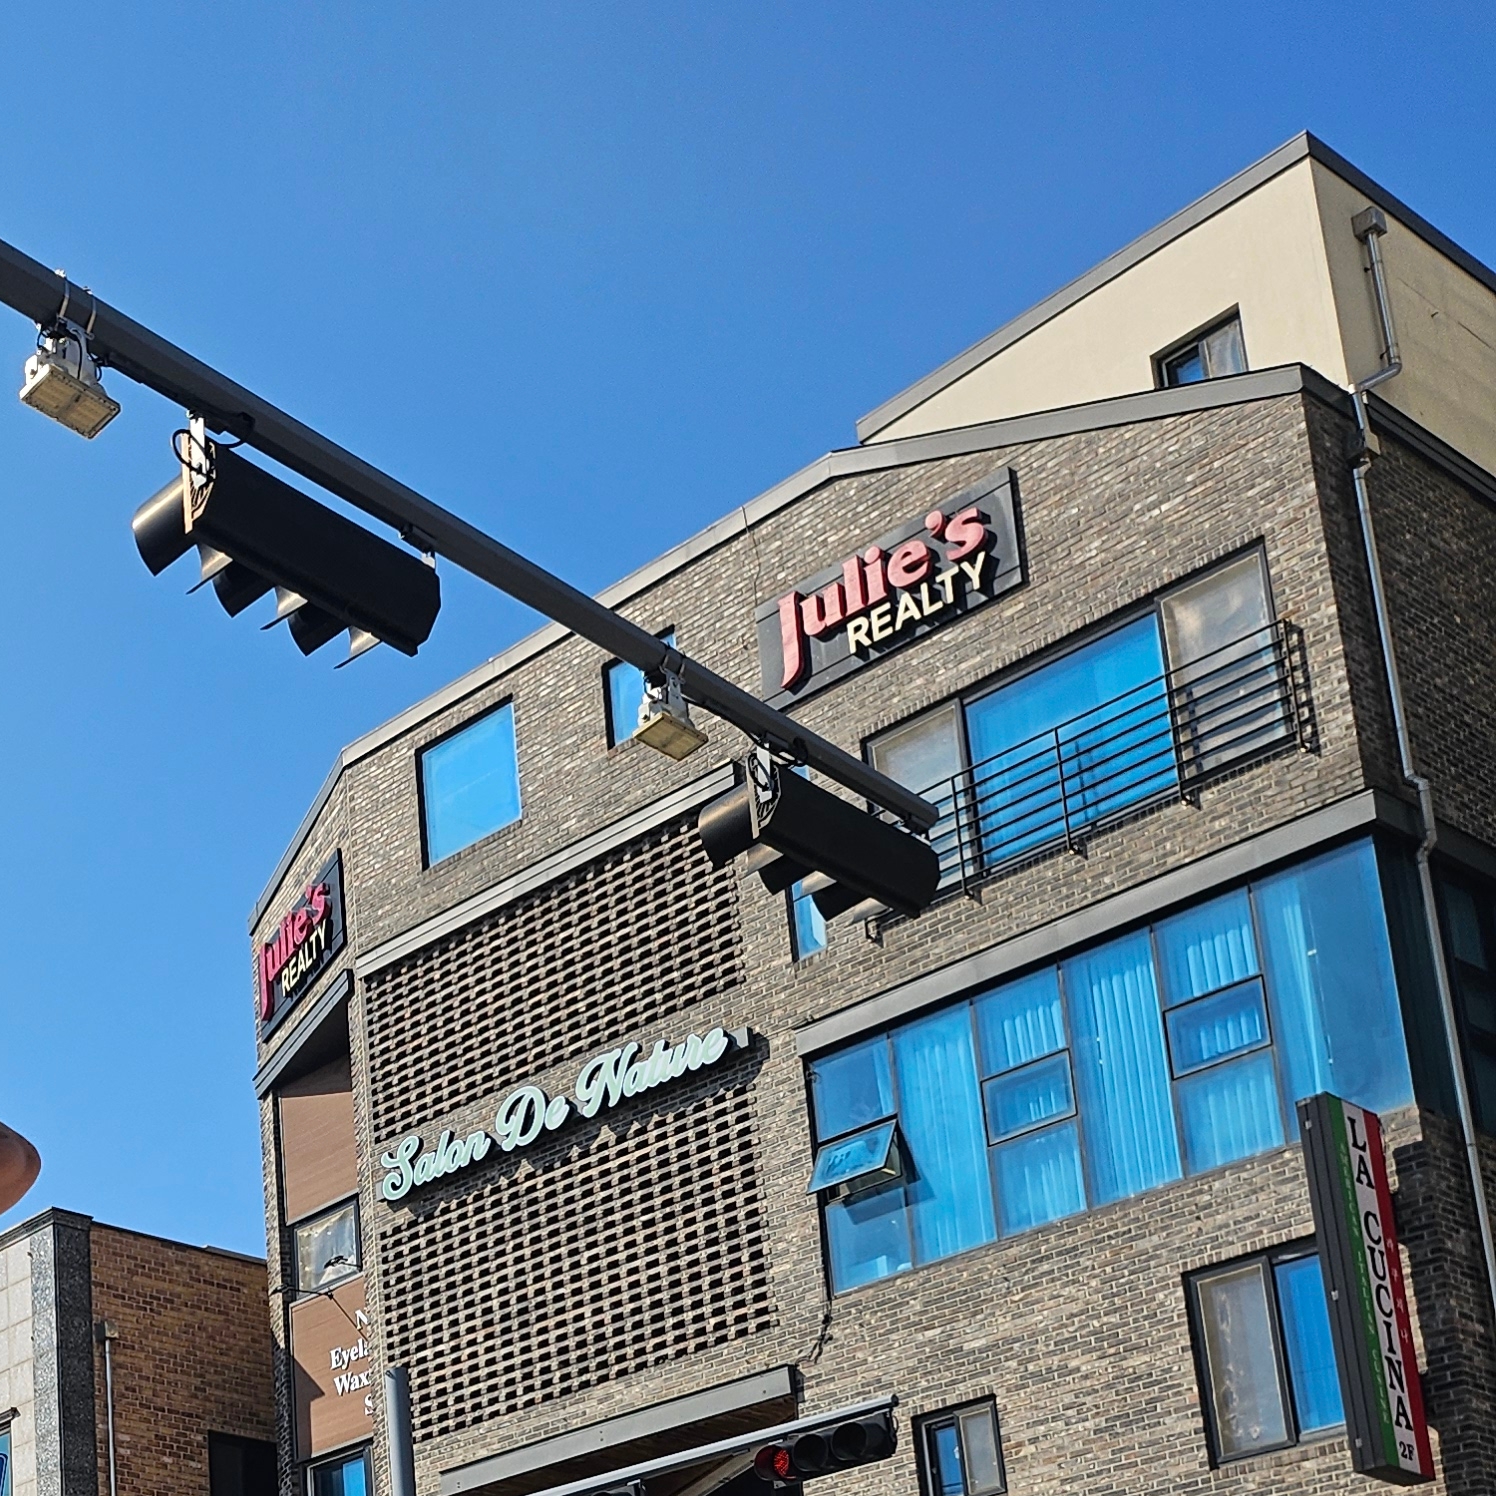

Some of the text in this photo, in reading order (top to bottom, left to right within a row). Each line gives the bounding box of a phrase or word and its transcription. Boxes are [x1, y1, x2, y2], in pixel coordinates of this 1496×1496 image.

[778, 507, 985, 688] Julie's
[846, 551, 986, 654] REALTY
[259, 882, 327, 1021] Julie's
[281, 919, 327, 997] REALTY
[380, 1026, 729, 1202] Salon De Nature
[1347, 1116, 1414, 1431] LA CUCINA
[334, 1370, 371, 1396] Wax
[1398, 1441, 1414, 1461] 2F
